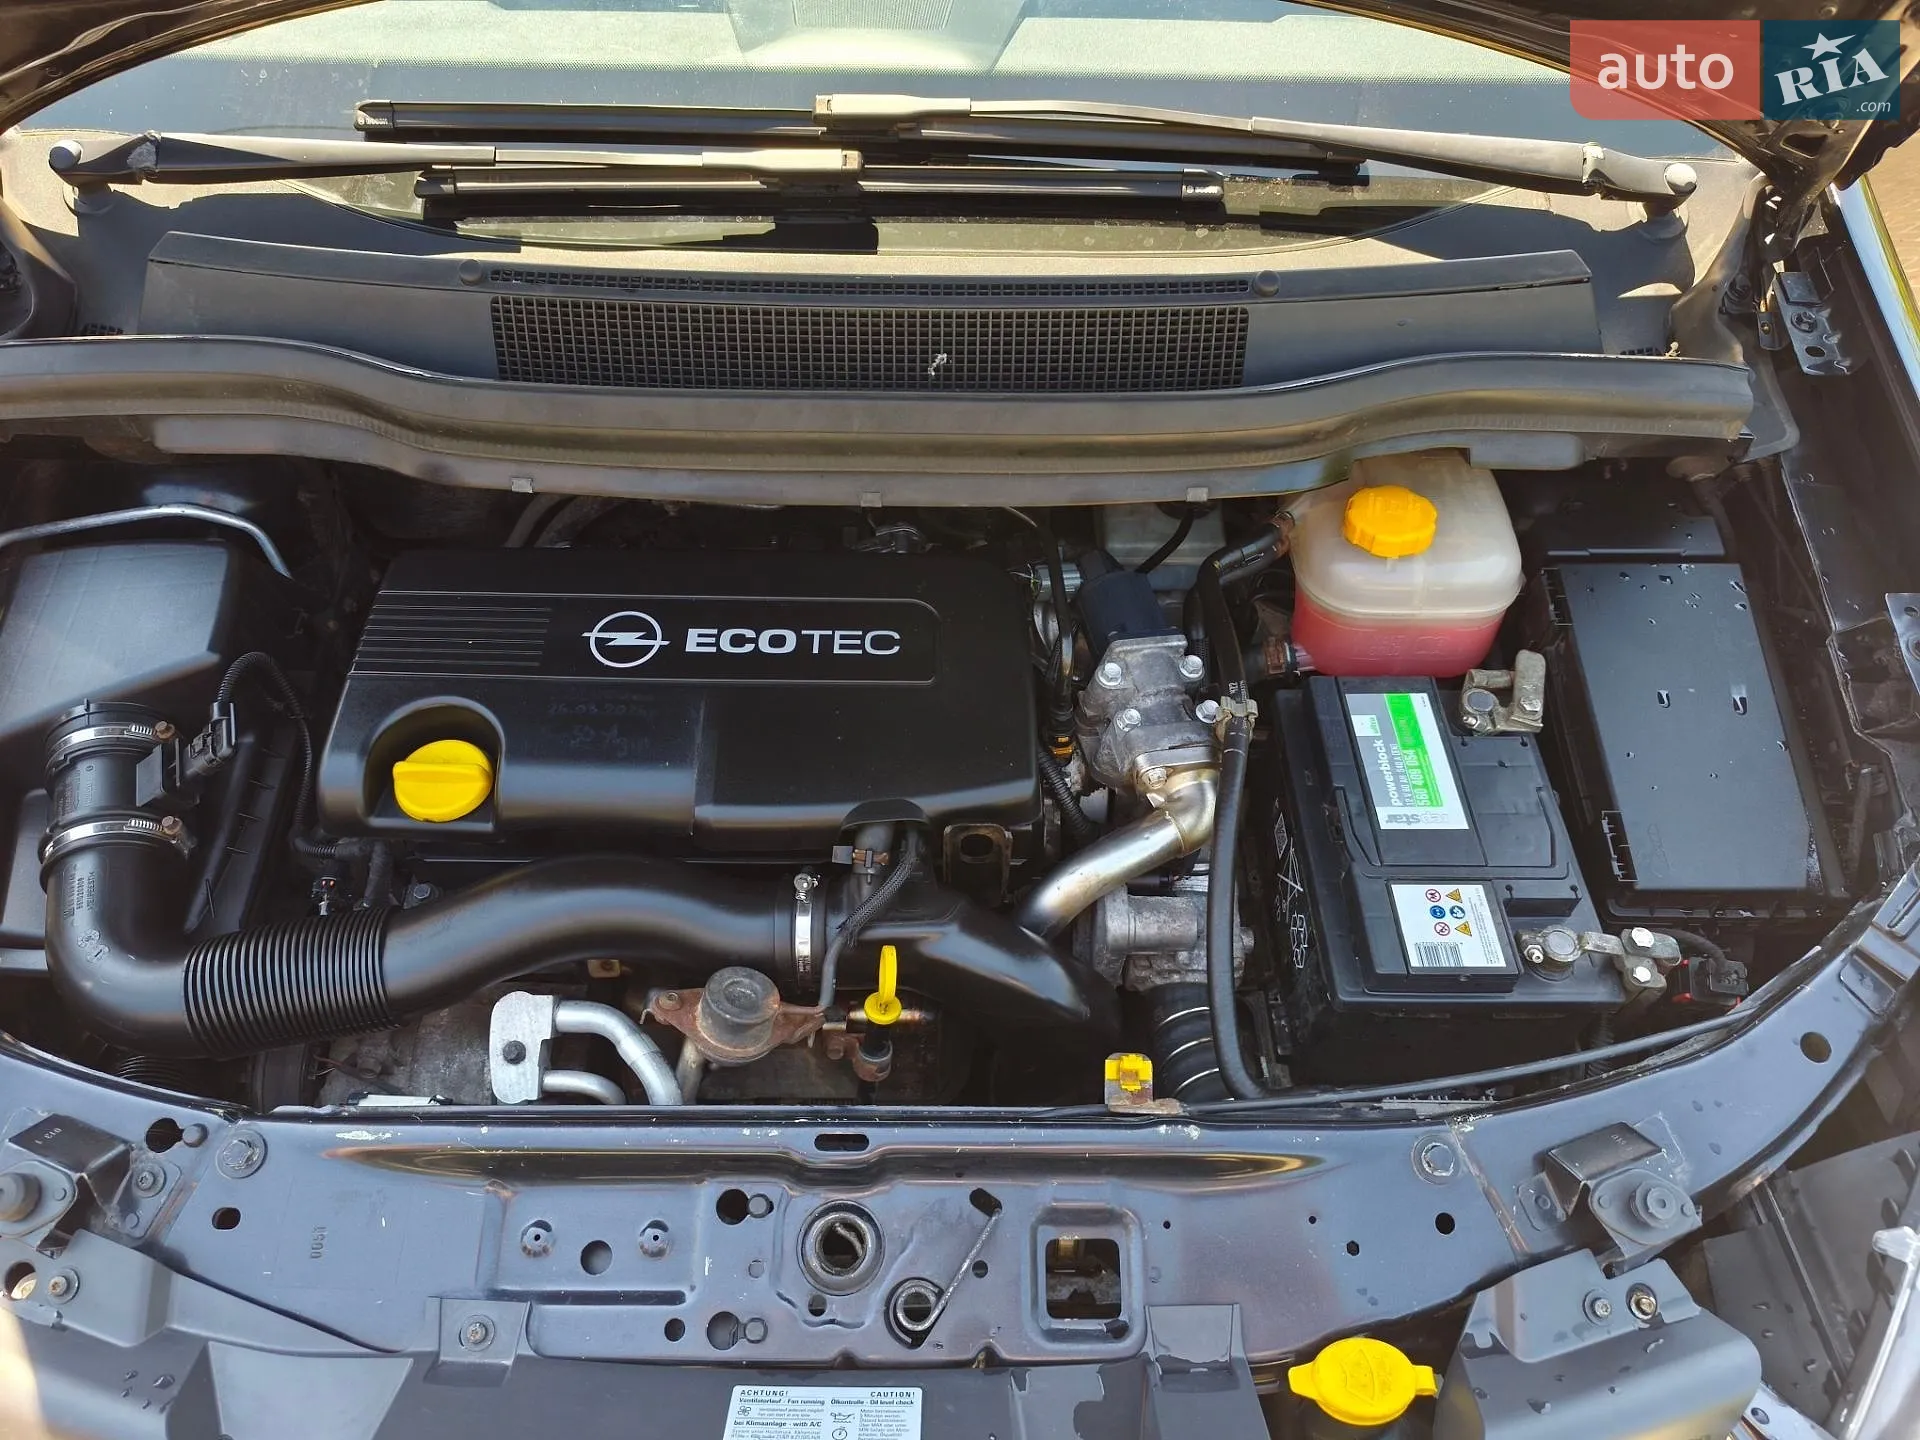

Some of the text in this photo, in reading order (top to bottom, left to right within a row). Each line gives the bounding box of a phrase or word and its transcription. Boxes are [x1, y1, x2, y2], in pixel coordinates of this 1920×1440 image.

[685, 628, 901, 655] ECOTEC
[1373, 739, 1402, 806] powerblock
[740, 1389, 788, 1397] ACHTUNG!
